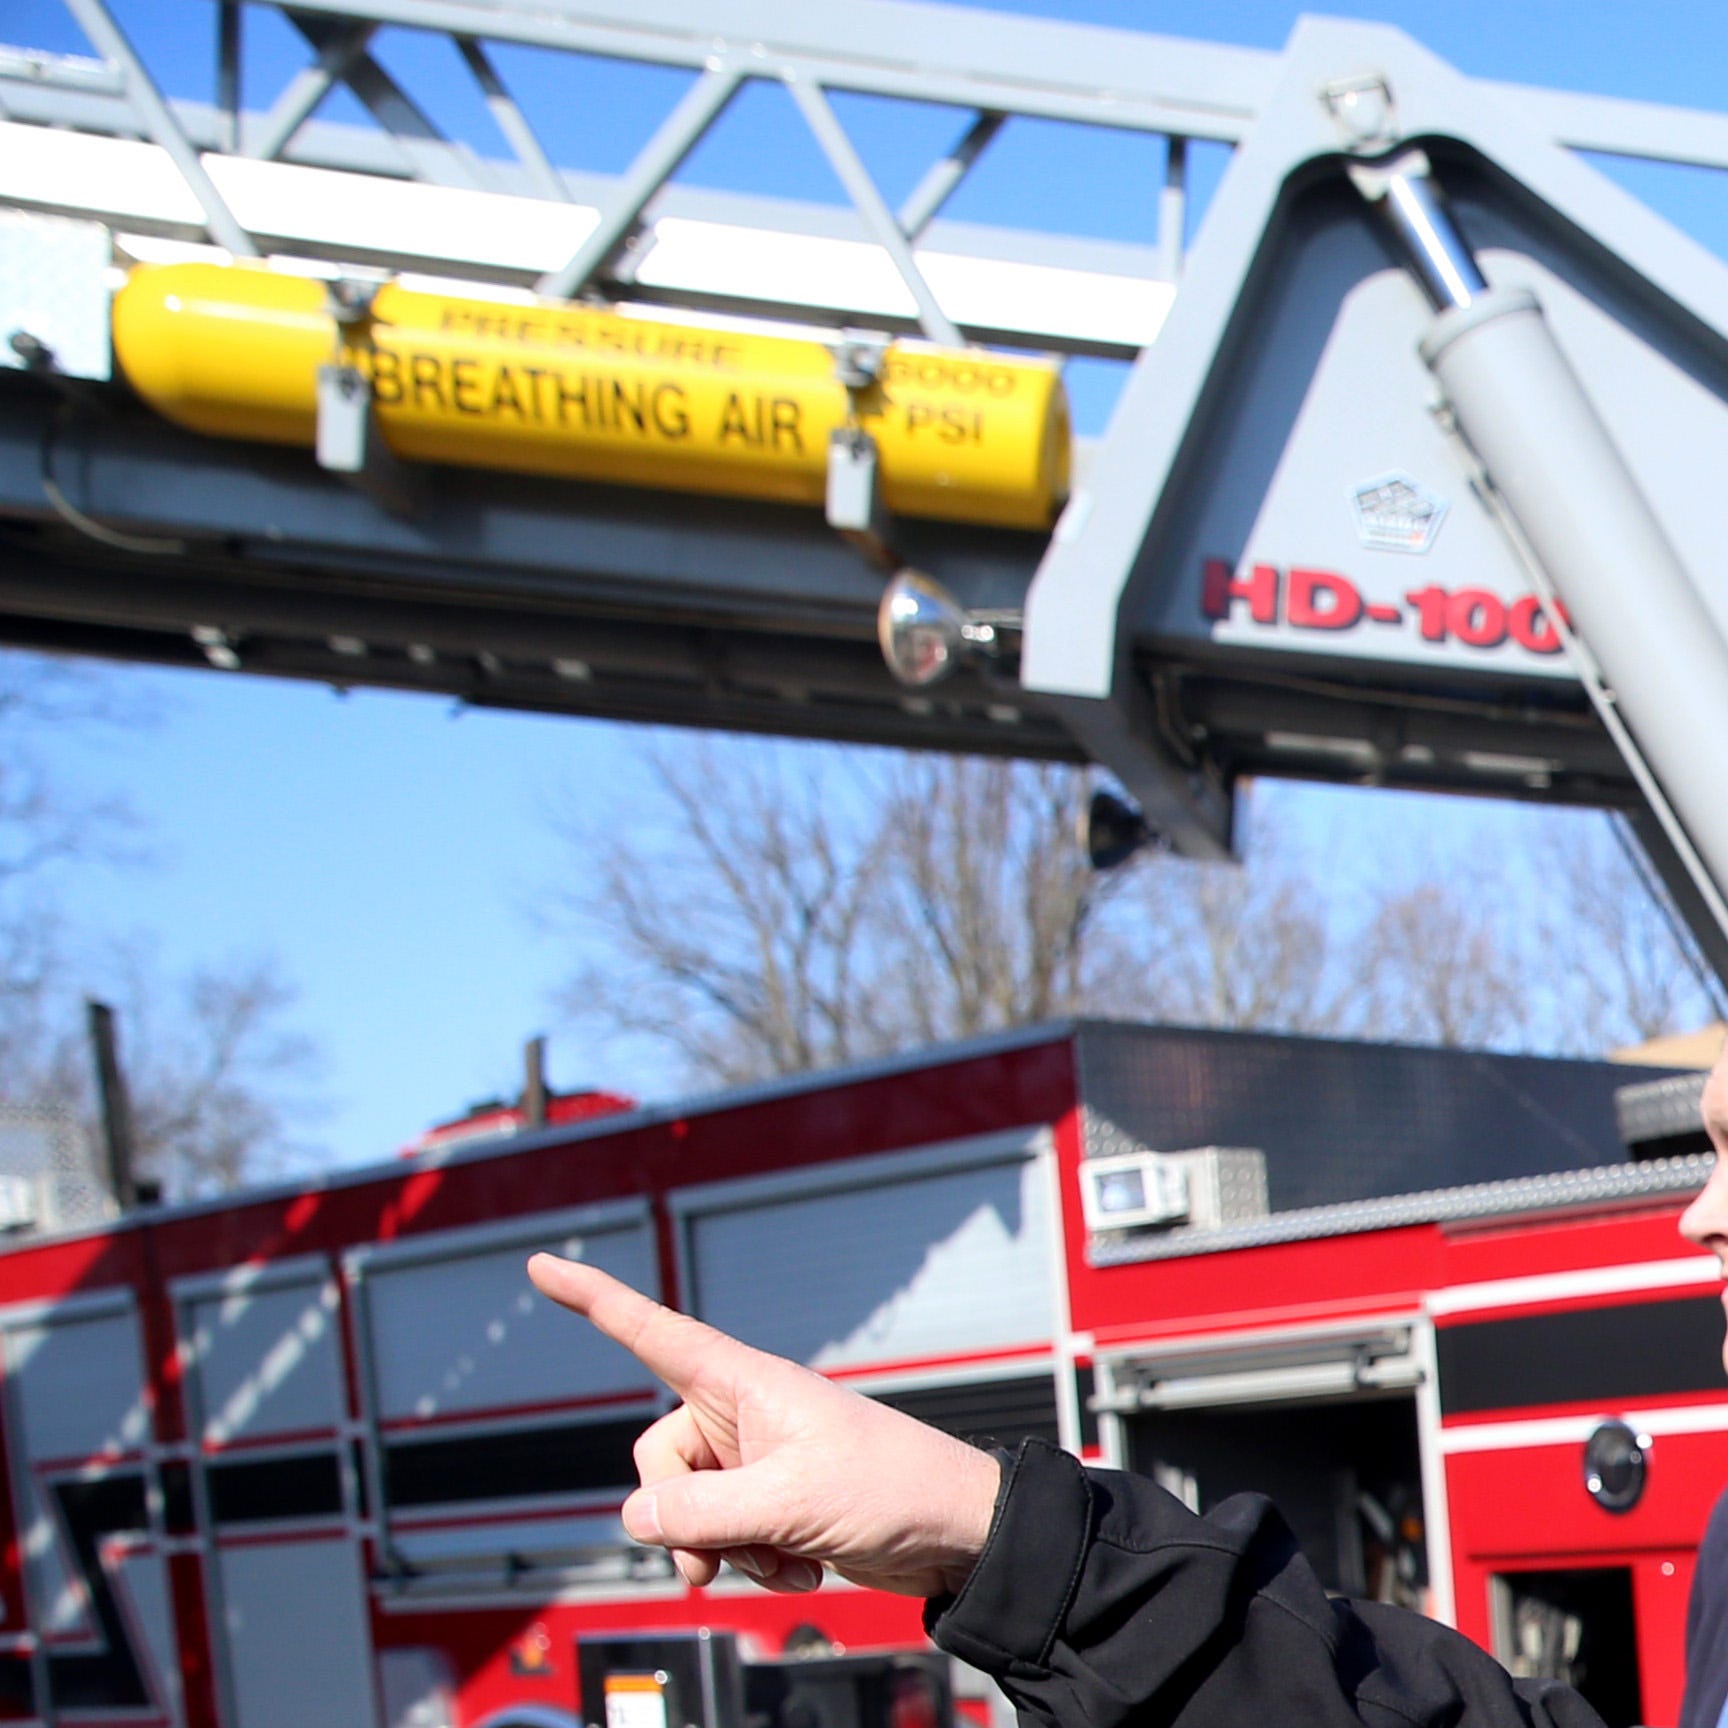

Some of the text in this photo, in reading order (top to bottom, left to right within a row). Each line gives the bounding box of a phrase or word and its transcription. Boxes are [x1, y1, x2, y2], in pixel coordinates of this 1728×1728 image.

[372, 350, 805, 453] BREATHING AIR
[903, 401, 986, 447] PSI
[1202, 558, 1577, 655] HD-100
